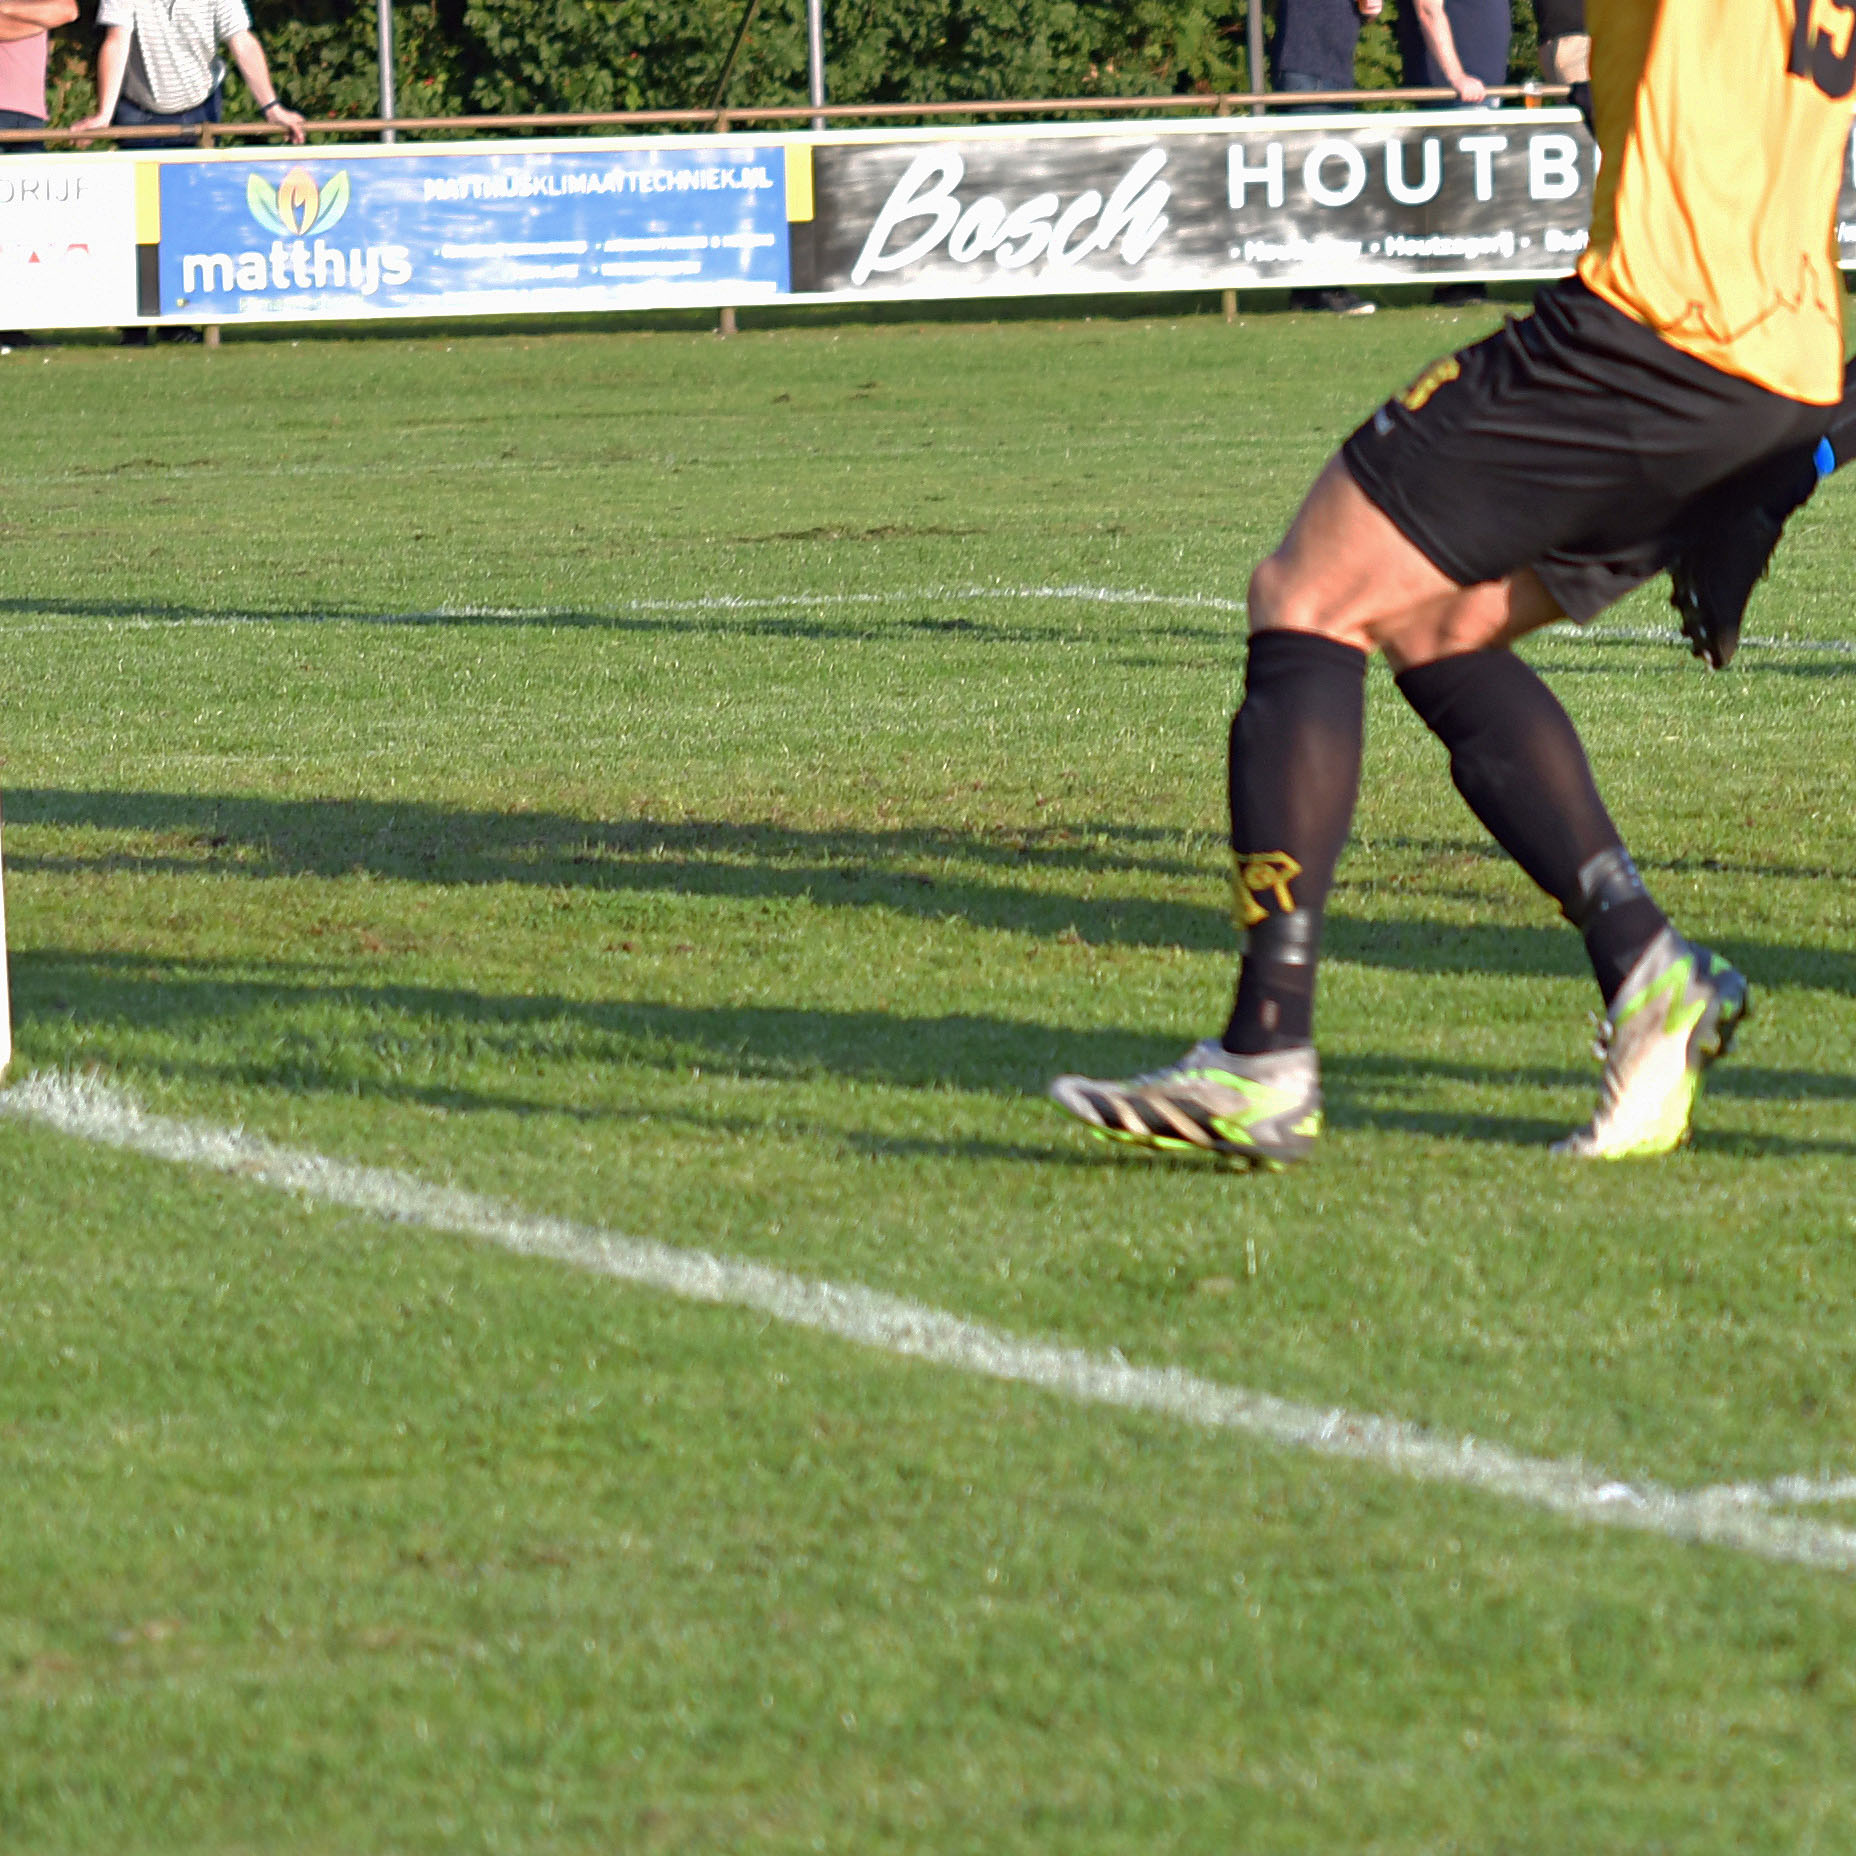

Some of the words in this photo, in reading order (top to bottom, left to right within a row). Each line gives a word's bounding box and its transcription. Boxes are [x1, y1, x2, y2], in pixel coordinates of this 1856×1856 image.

[1228, 134, 1602, 209] HOUTB
[850, 147, 1171, 286] Bosch
[182, 239, 412, 295] matthijs
